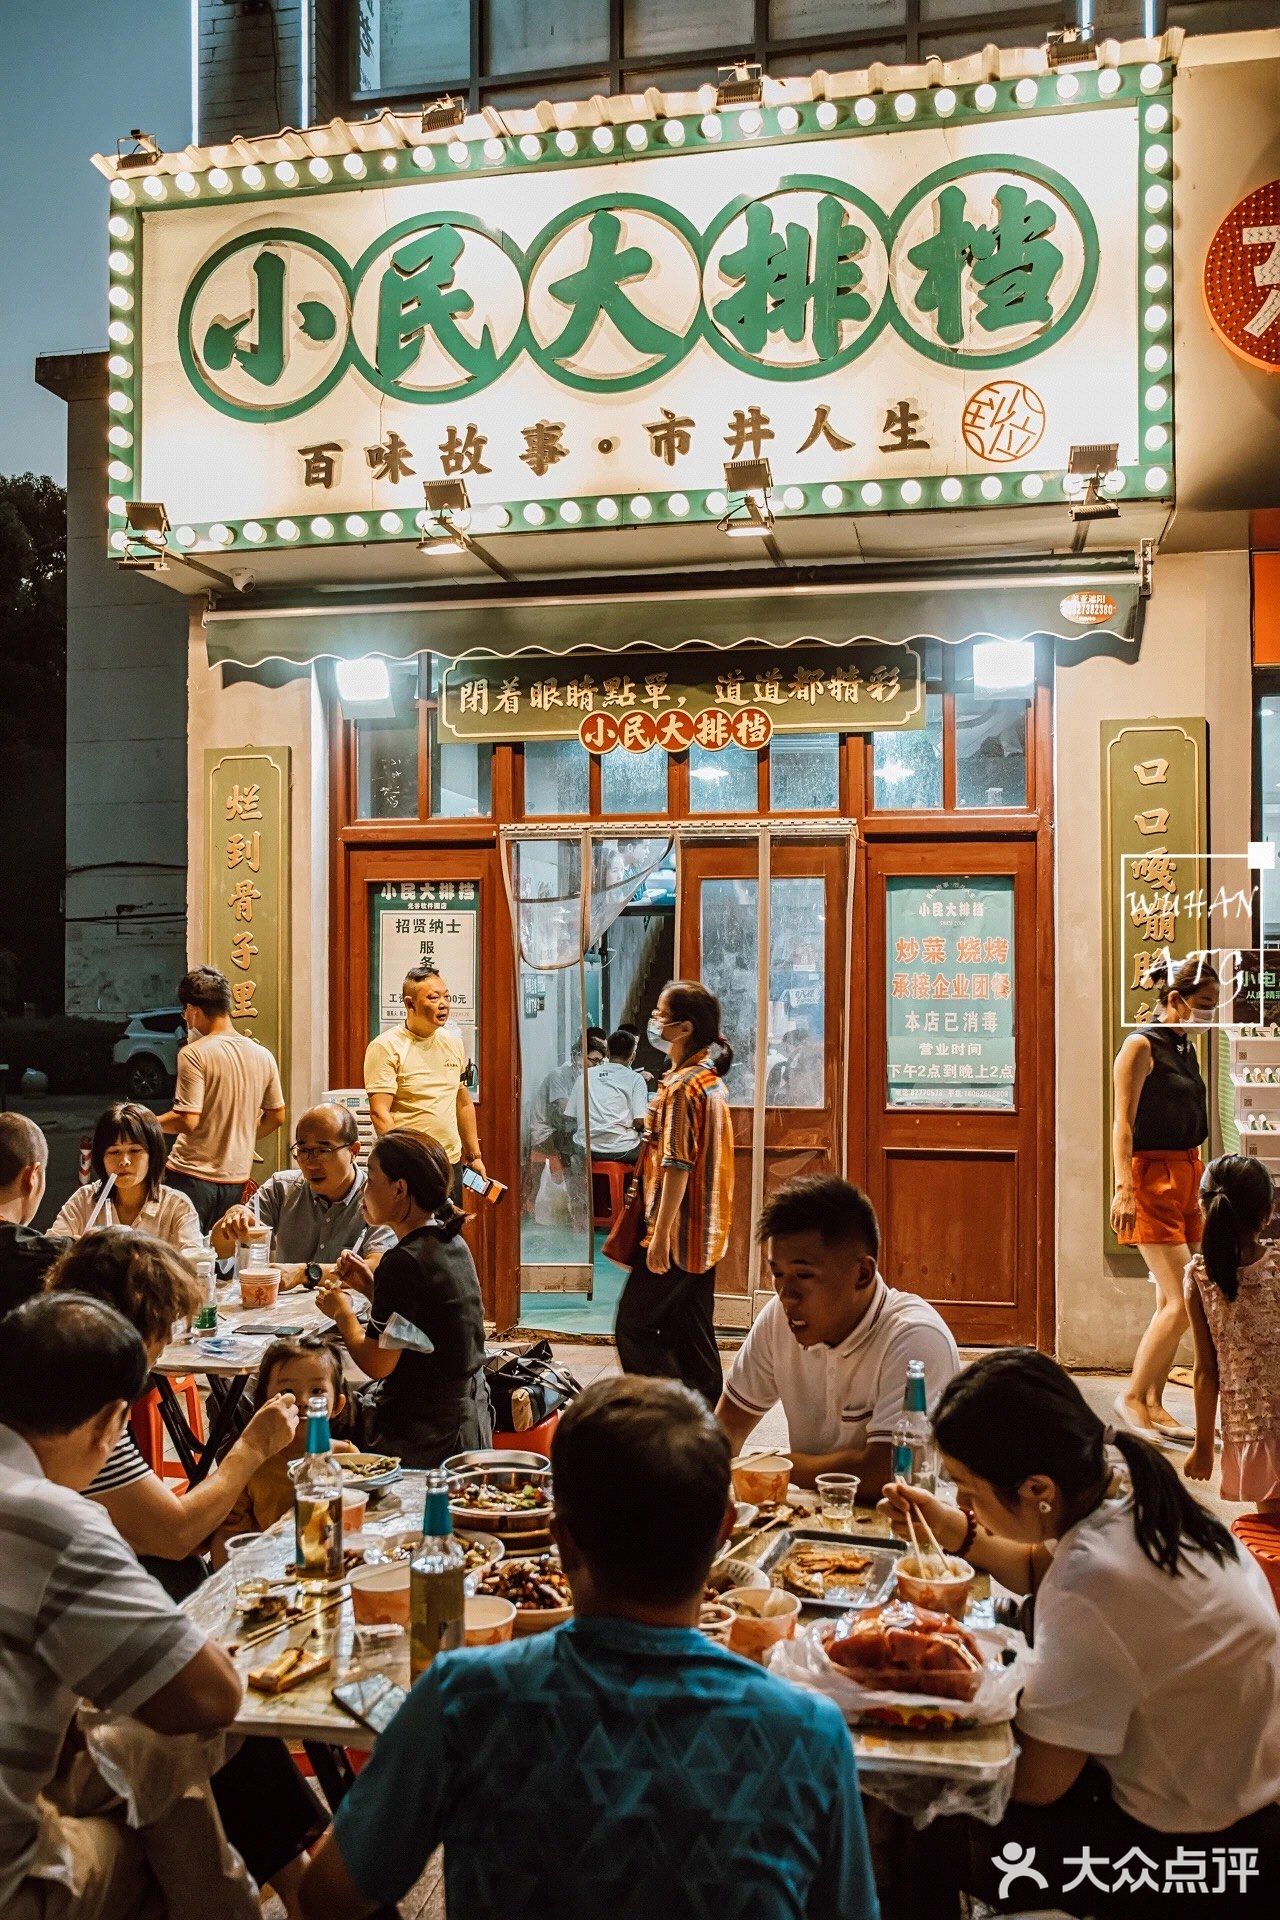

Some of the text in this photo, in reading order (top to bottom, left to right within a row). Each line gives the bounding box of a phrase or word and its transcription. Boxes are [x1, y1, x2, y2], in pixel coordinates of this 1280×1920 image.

[203, 185, 1064, 387] 小民大排档
[298, 401, 932, 488] 百味故事·市井人生
[584, 711, 768, 750] 小民大排档
[381, 882, 475, 900] 小民大排档
[919, 901, 984, 917] 小民大排档
[395, 918, 461, 934] 招贤纳士
[895, 936, 1010, 964] 炒菜 烧烤
[891, 972, 1012, 1000] 承接企业团餐
[904, 1010, 998, 1032] 本店已消毒
[919, 1042, 982, 1056] 营业时间
[887, 1063, 1014, 1079] 下午2点到晚上2点
